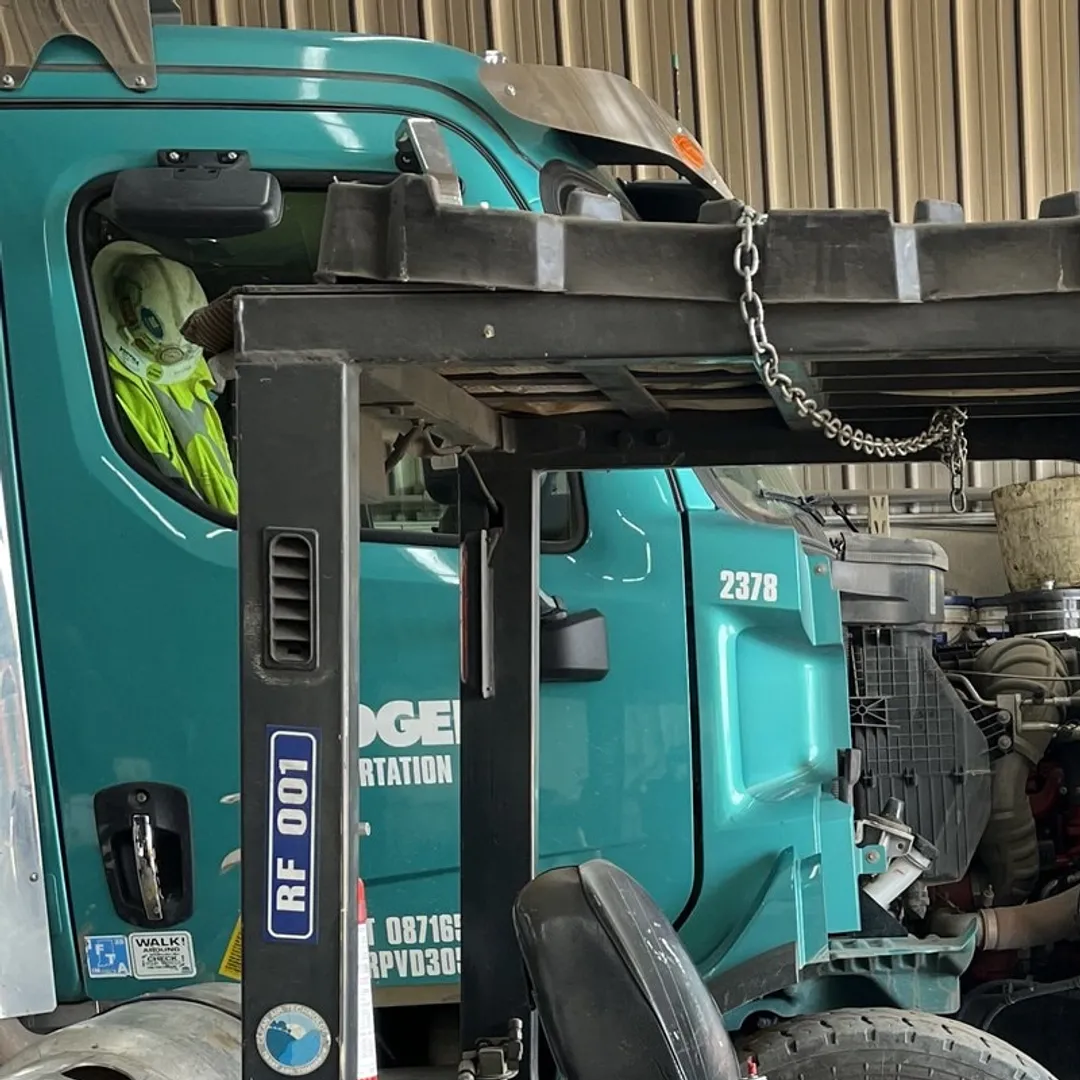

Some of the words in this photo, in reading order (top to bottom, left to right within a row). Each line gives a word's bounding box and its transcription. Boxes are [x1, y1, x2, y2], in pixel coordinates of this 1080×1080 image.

[720, 569, 778, 602] 2378
[276, 758, 309, 836] 001
[276, 857, 306, 913] RF
